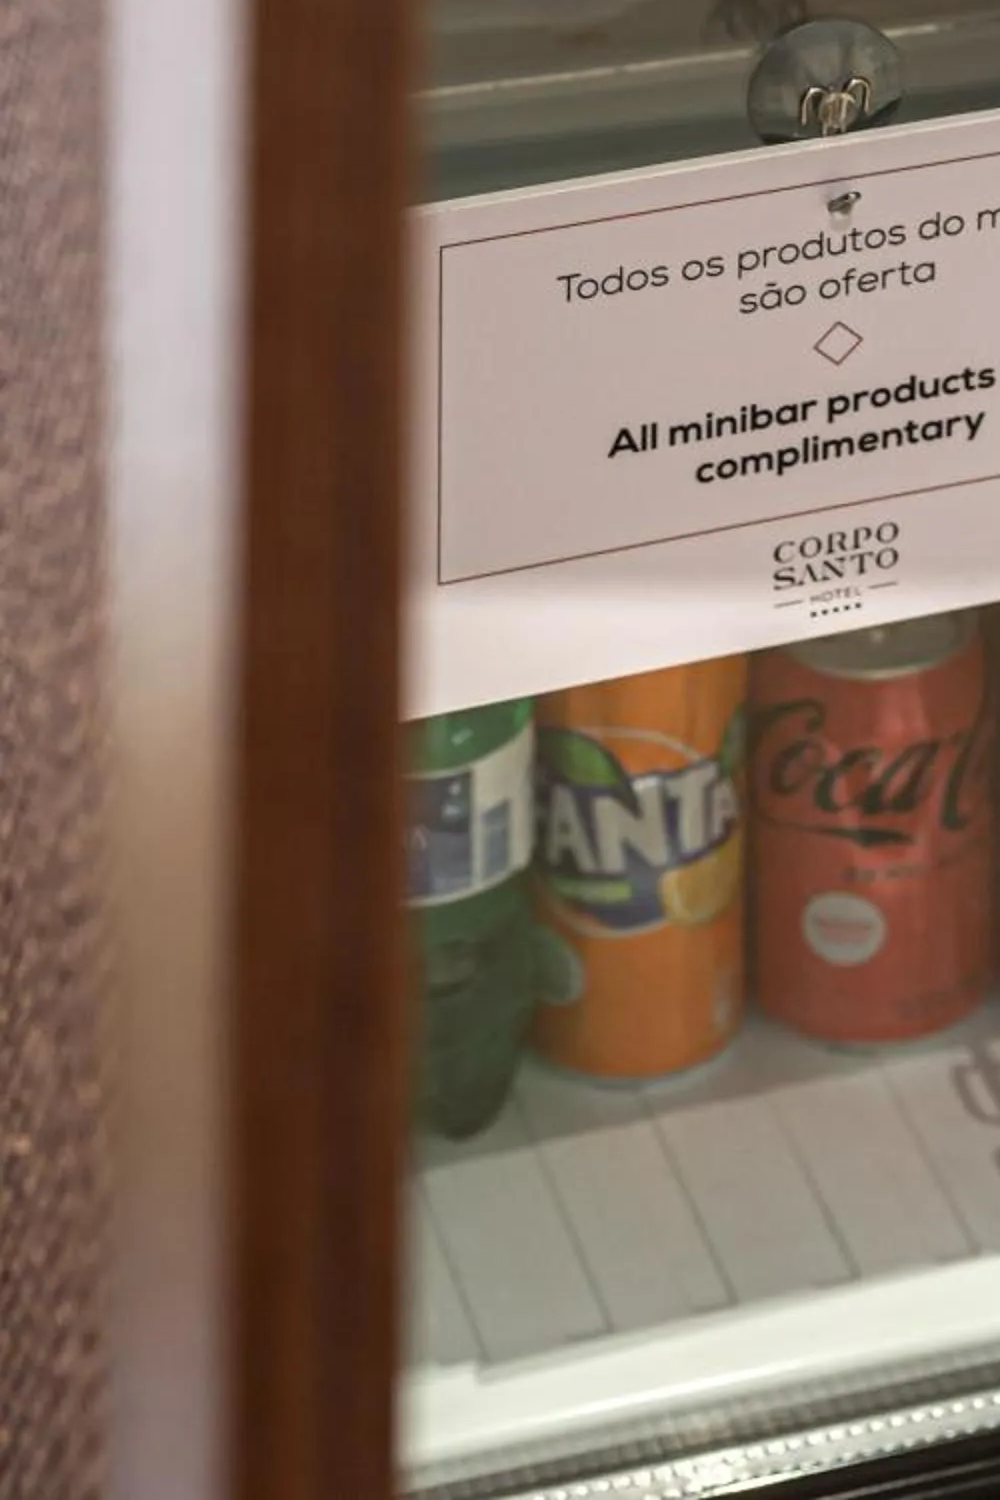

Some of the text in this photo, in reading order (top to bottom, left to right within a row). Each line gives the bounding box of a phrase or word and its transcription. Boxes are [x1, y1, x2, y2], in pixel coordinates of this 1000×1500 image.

[558, 263, 670, 303] Todos
[680, 252, 726, 283] os
[736, 224, 908, 280] produtos
[917, 209, 967, 239] do
[738, 258, 937, 315] são oferta
[607, 421, 659, 459] All
[667, 396, 819, 448] minibar
[825, 365, 996, 418] products
[694, 411, 987, 484] complimentary
[773, 521, 899, 564] CORPO
[773, 547, 899, 591] SANTO
[808, 586, 862, 603] HOTEL
[545, 760, 738, 875] ANTA
